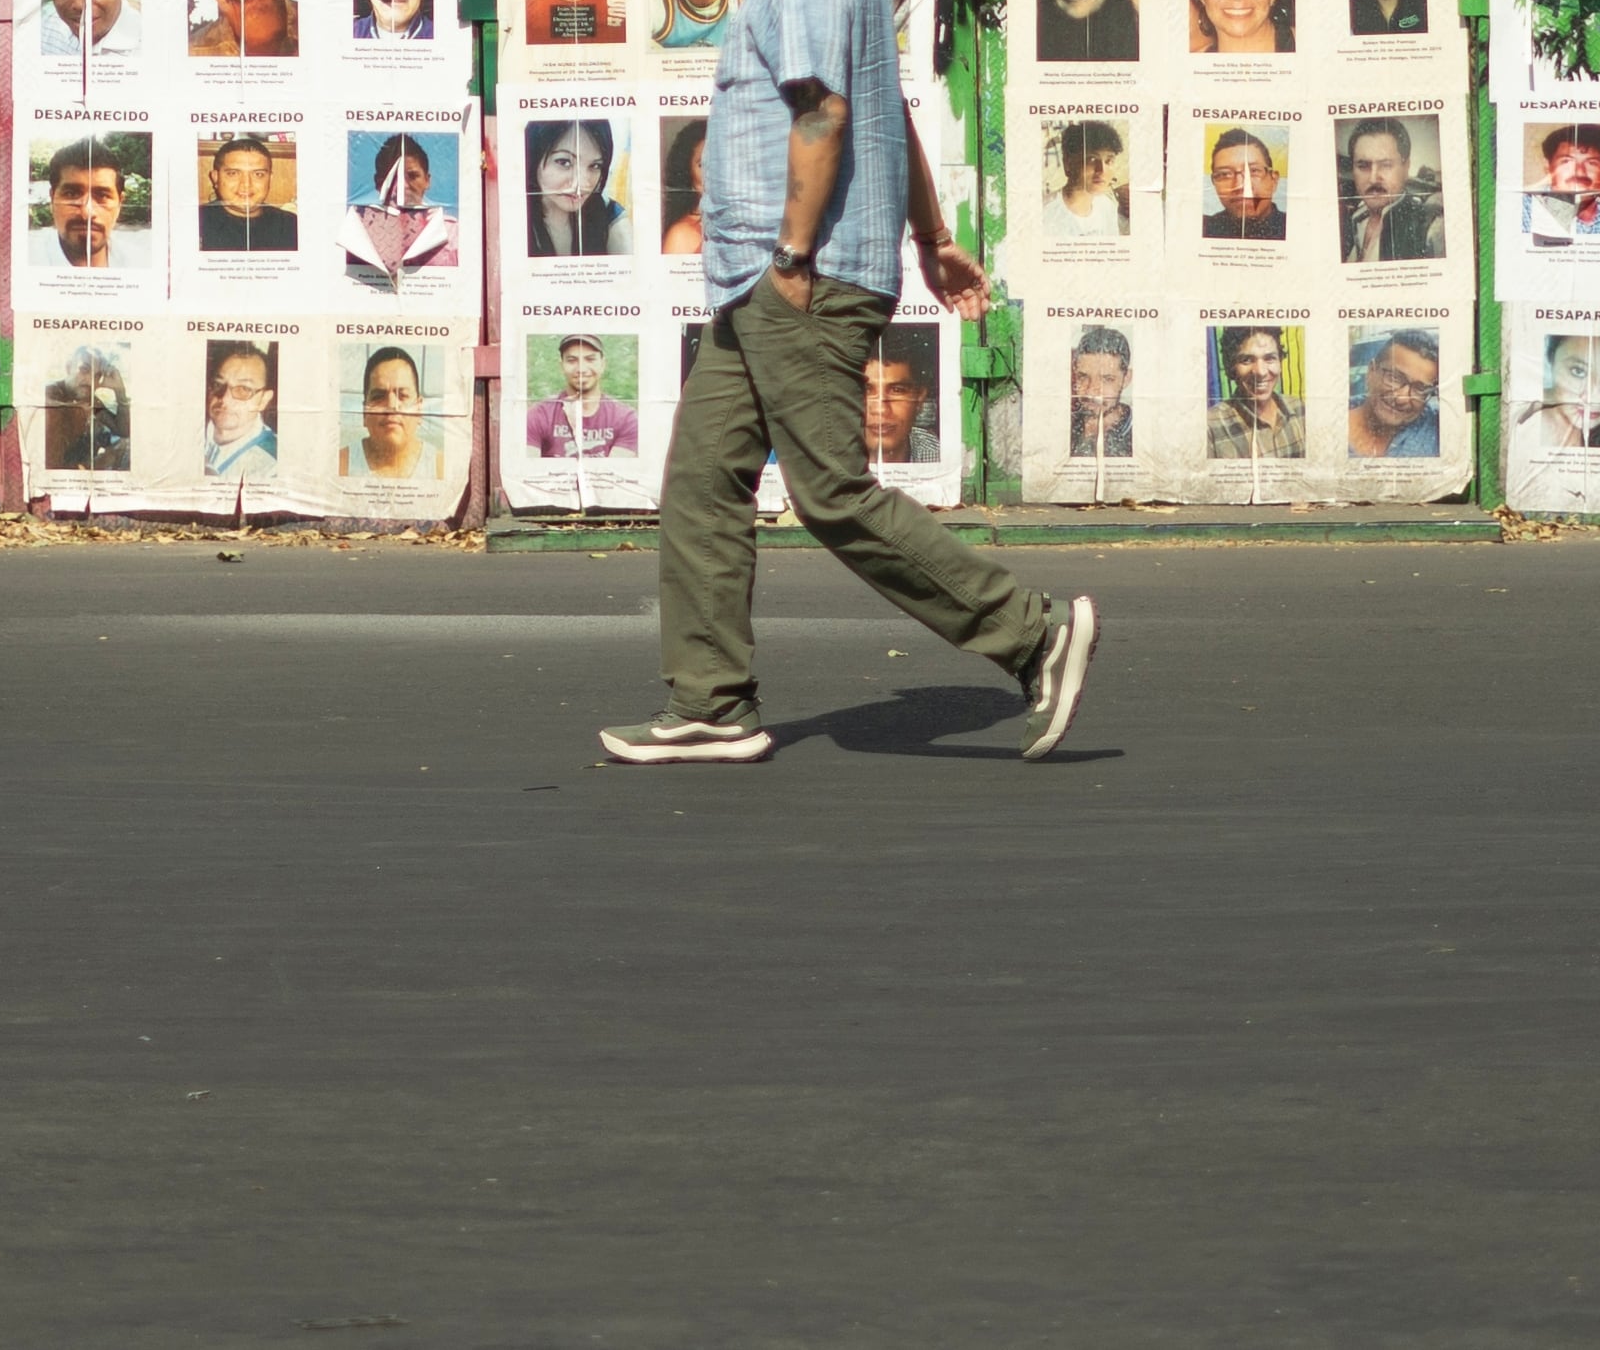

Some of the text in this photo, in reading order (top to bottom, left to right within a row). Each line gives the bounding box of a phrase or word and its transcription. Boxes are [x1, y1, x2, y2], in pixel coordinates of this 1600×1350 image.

[519, 96, 637, 109] DESAPARECIDA
[1327, 99, 1445, 116] DESAPARECIDO
[34, 109, 149, 122] DESAPARECIDO
[345, 109, 463, 123] DESAPARECIDO
[1029, 104, 1140, 115] DESAPARECIDO
[1192, 108, 1303, 122] DESAPARECIDO
[190, 112, 304, 123] DESAPARECIDO
[522, 305, 641, 317] DESAPARECIDO
[1047, 307, 1159, 319] DESAPARECIDO
[1199, 308, 1311, 320] DESAPARECIDO
[1338, 307, 1450, 319] DESAPARECIDO
[33, 318, 144, 331] DESAPARECIDO
[186, 321, 300, 335] DESAPARECIDO
[336, 323, 450, 337] DESAPARECIDO
